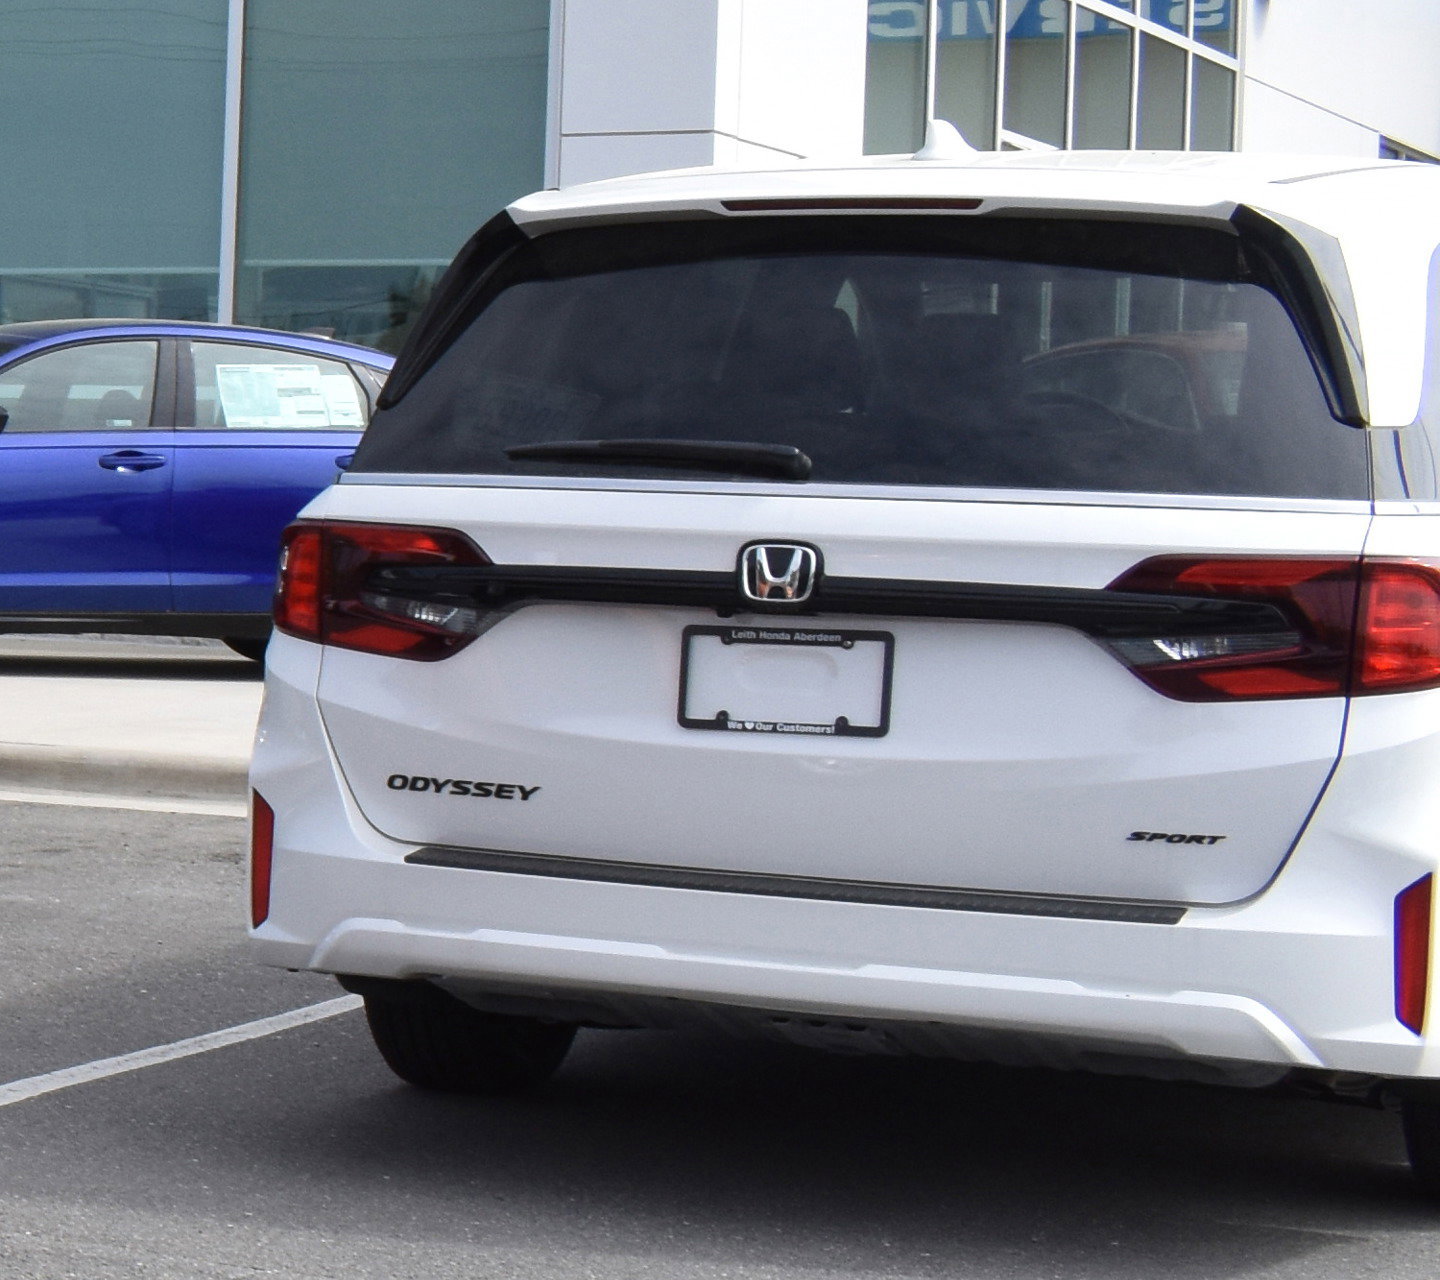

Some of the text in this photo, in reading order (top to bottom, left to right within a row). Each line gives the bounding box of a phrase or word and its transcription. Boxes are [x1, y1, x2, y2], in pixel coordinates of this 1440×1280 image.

[731, 630, 842, 642] Leith Honda Aberdeen
[727, 721, 835, 734] We Our Customers!
[387, 774, 541, 801] ODYSSEY
[1126, 831, 1226, 845] SPORT
